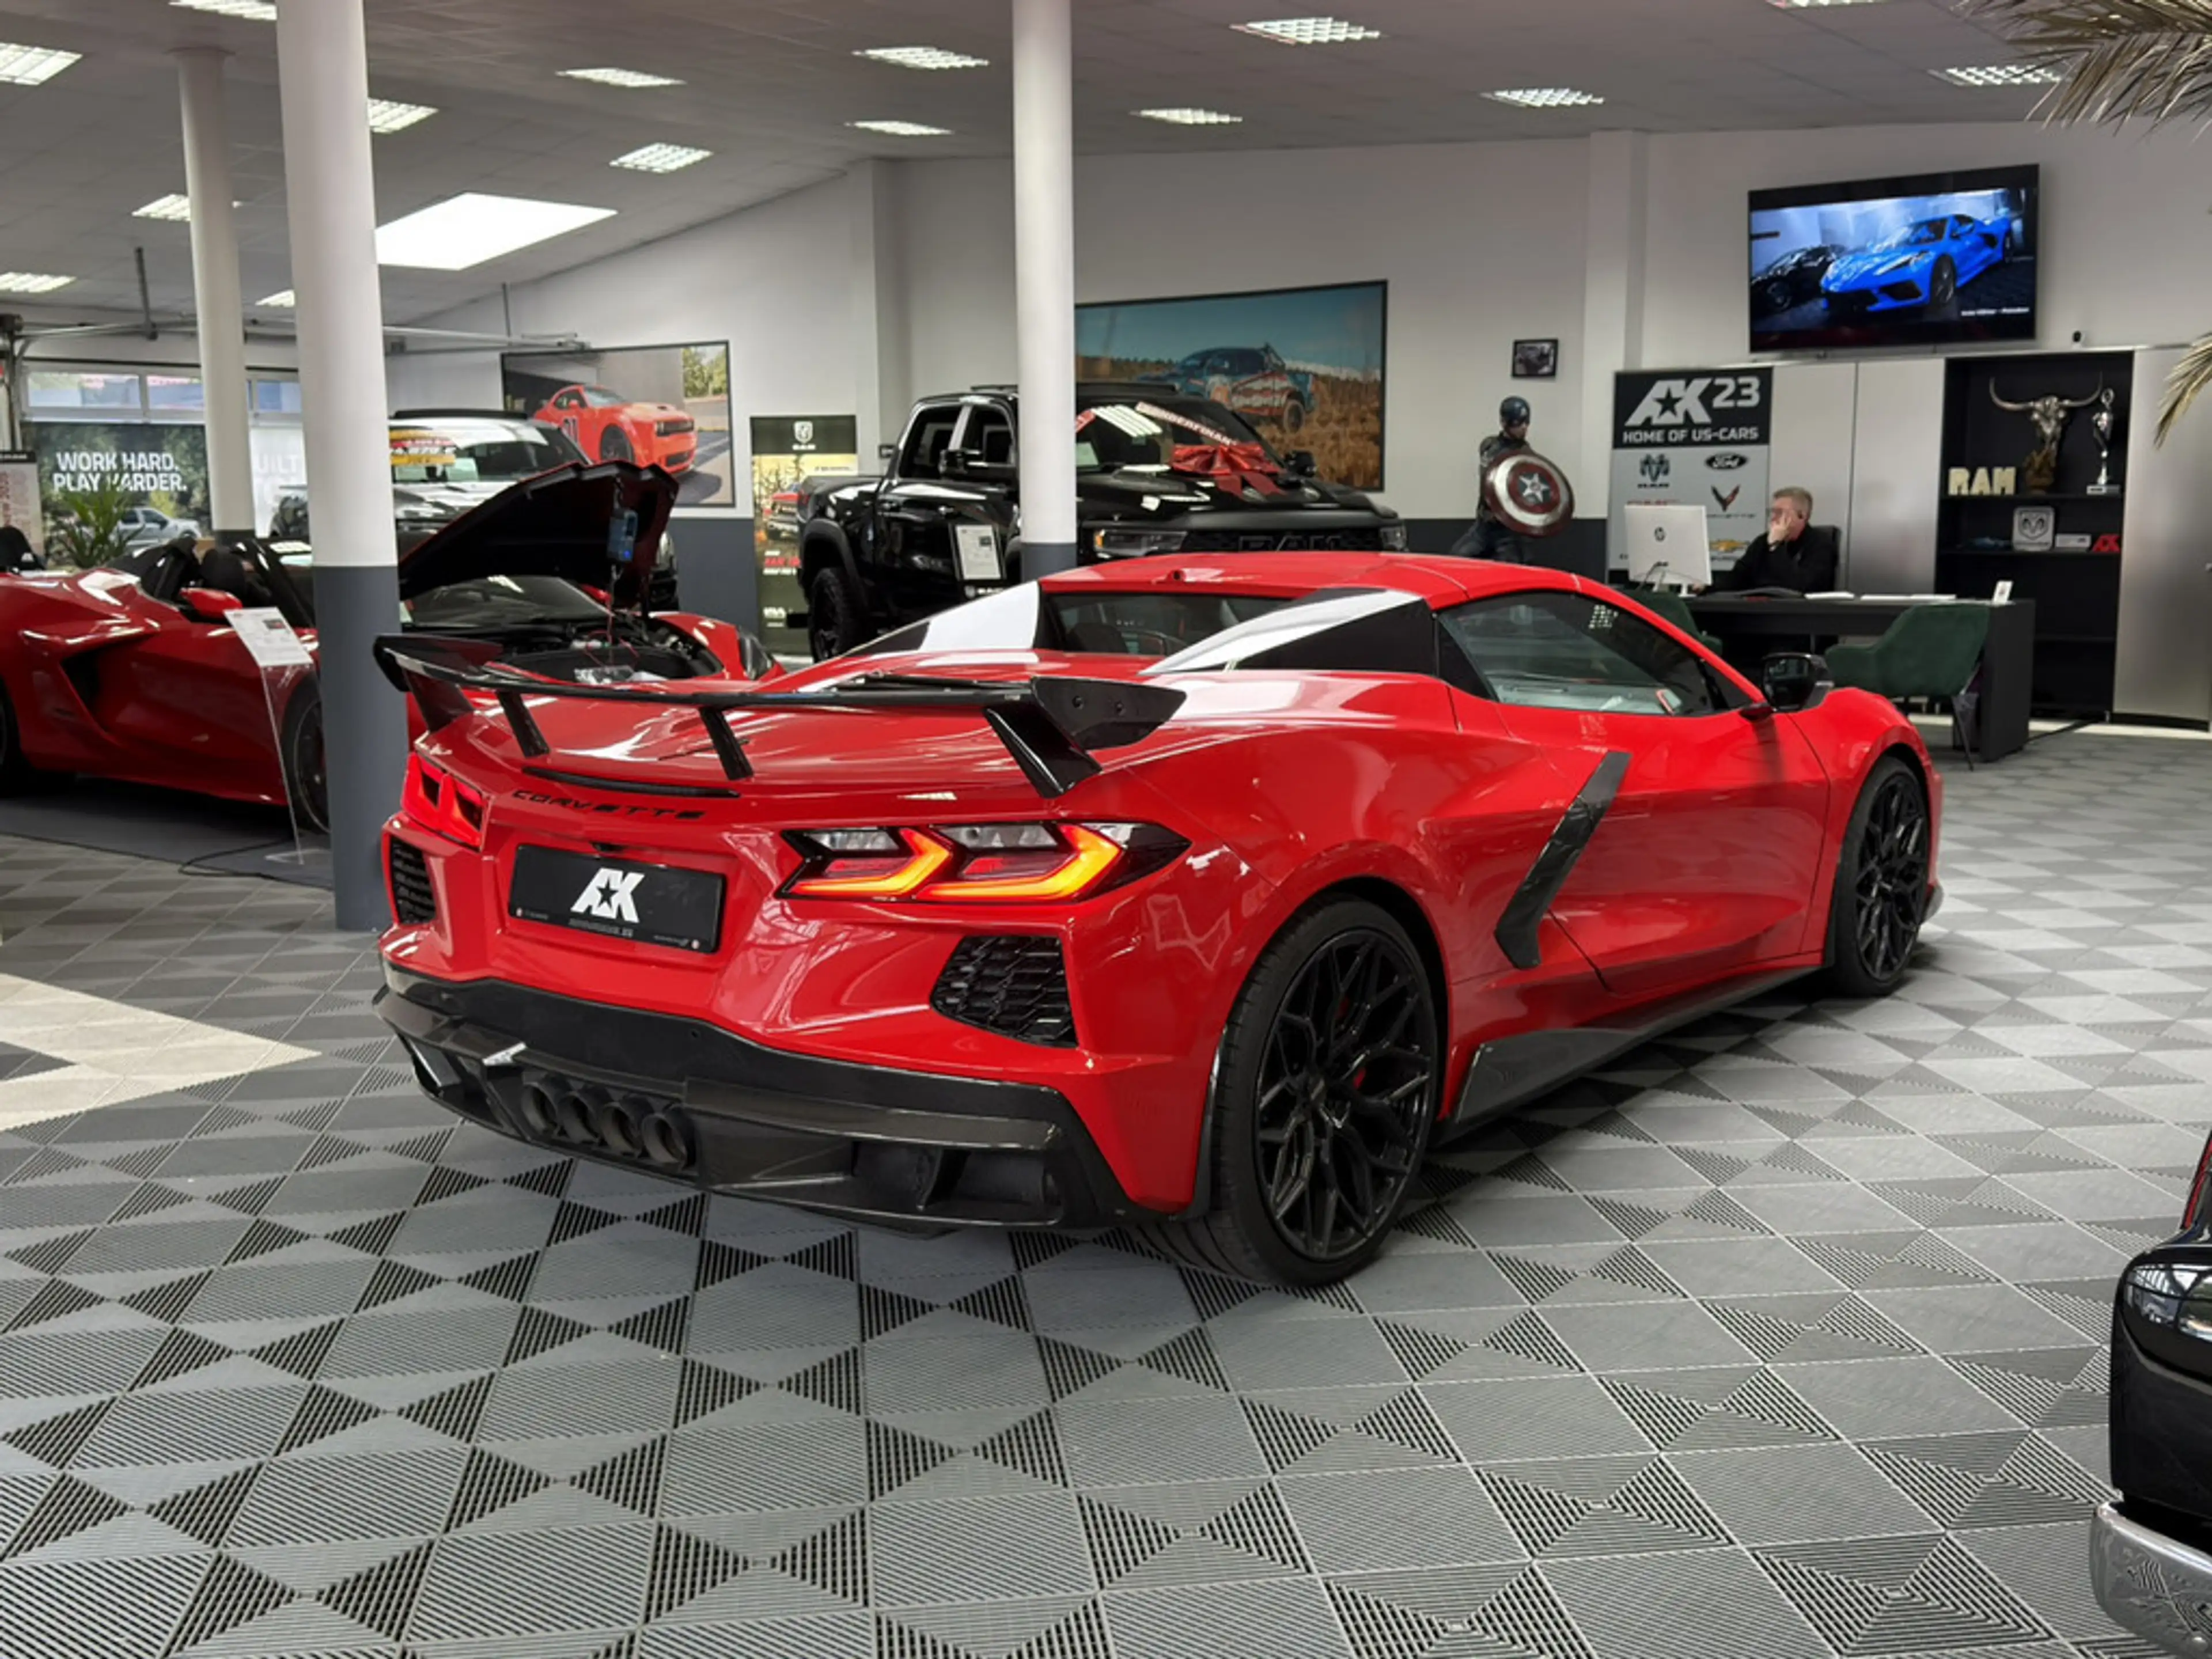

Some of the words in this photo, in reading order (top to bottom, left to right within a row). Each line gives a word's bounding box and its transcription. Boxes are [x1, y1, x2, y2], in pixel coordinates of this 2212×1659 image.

[1623, 430, 1665, 444] HOME
[1668, 429, 1688, 442] OF
[1691, 427, 1759, 441] US-CARS
[56, 452, 117, 471] WORK
[122, 452, 179, 471] HARD.
[252, 453, 299, 474] UILT
[54, 472, 100, 492] PLAY
[1948, 467, 2016, 495] RAM
[512, 790, 706, 820] CORVETTE
[570, 868, 645, 923] AK
